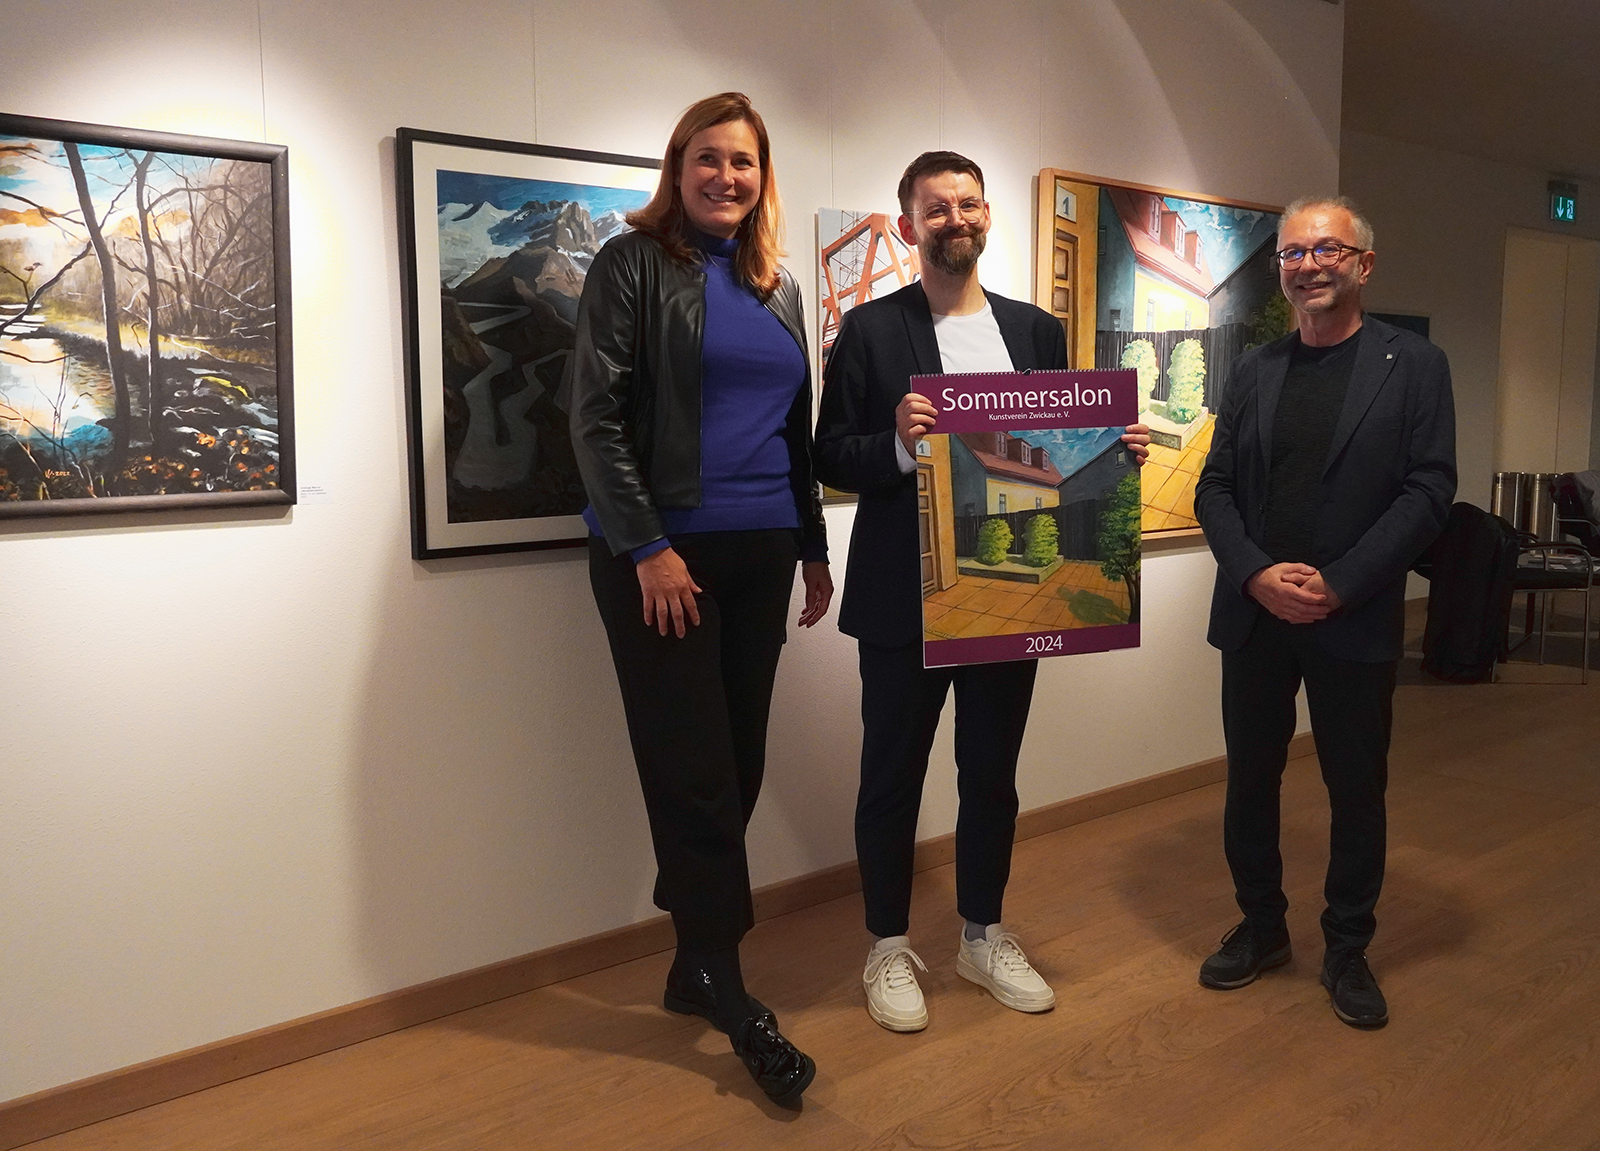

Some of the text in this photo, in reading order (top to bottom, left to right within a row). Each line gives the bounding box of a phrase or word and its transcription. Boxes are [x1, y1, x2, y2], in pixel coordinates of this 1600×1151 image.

[1062, 196, 1070, 216] 1
[942, 383, 1111, 411] Sommersalon
[989, 413, 1027, 421] Kunstverein
[1028, 411, 1056, 419] Zwickau
[1063, 410, 1071, 418] V.
[918, 443, 925, 455] 1
[1025, 634, 1064, 653] 2024
